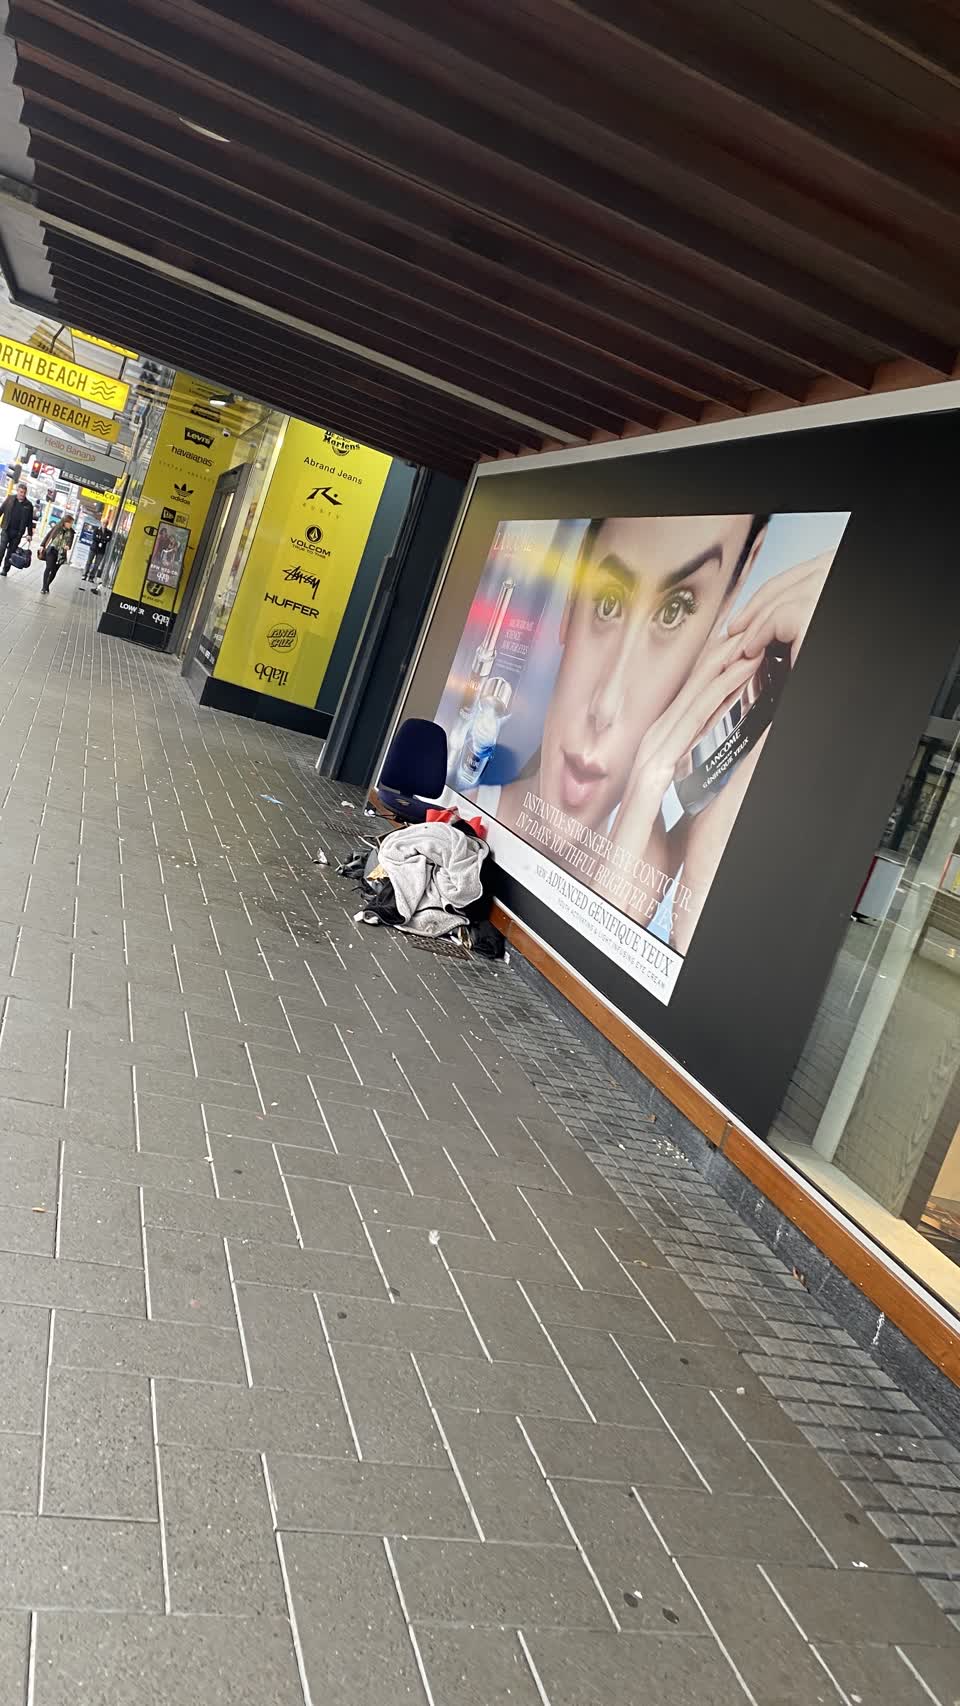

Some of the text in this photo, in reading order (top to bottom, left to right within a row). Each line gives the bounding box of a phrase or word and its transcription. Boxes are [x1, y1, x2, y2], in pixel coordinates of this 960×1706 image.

[0, 342, 34, 372] RTH
[36, 358, 89, 392] BEACH
[12, 388, 91, 429] NORTH BEACH
[44, 436, 96, 462] Hello Banana
[304, 456, 363, 485] Abrand Jeans
[170, 495, 191, 505] adidas
[290, 537, 331, 557] VOLCOM
[264, 592, 320, 619] HUFFER
[566, 816, 613, 861] STRONGER
[515, 811, 528, 829] IN
[525, 819, 533, 832] 7
[550, 833, 597, 877] YOUTHFUL
[594, 864, 648, 913] BRIGHTER
[545, 871, 588, 911] ADVANCED
[588, 901, 642, 952] GÉNIFIQUE
[640, 939, 674, 978] YEUX
